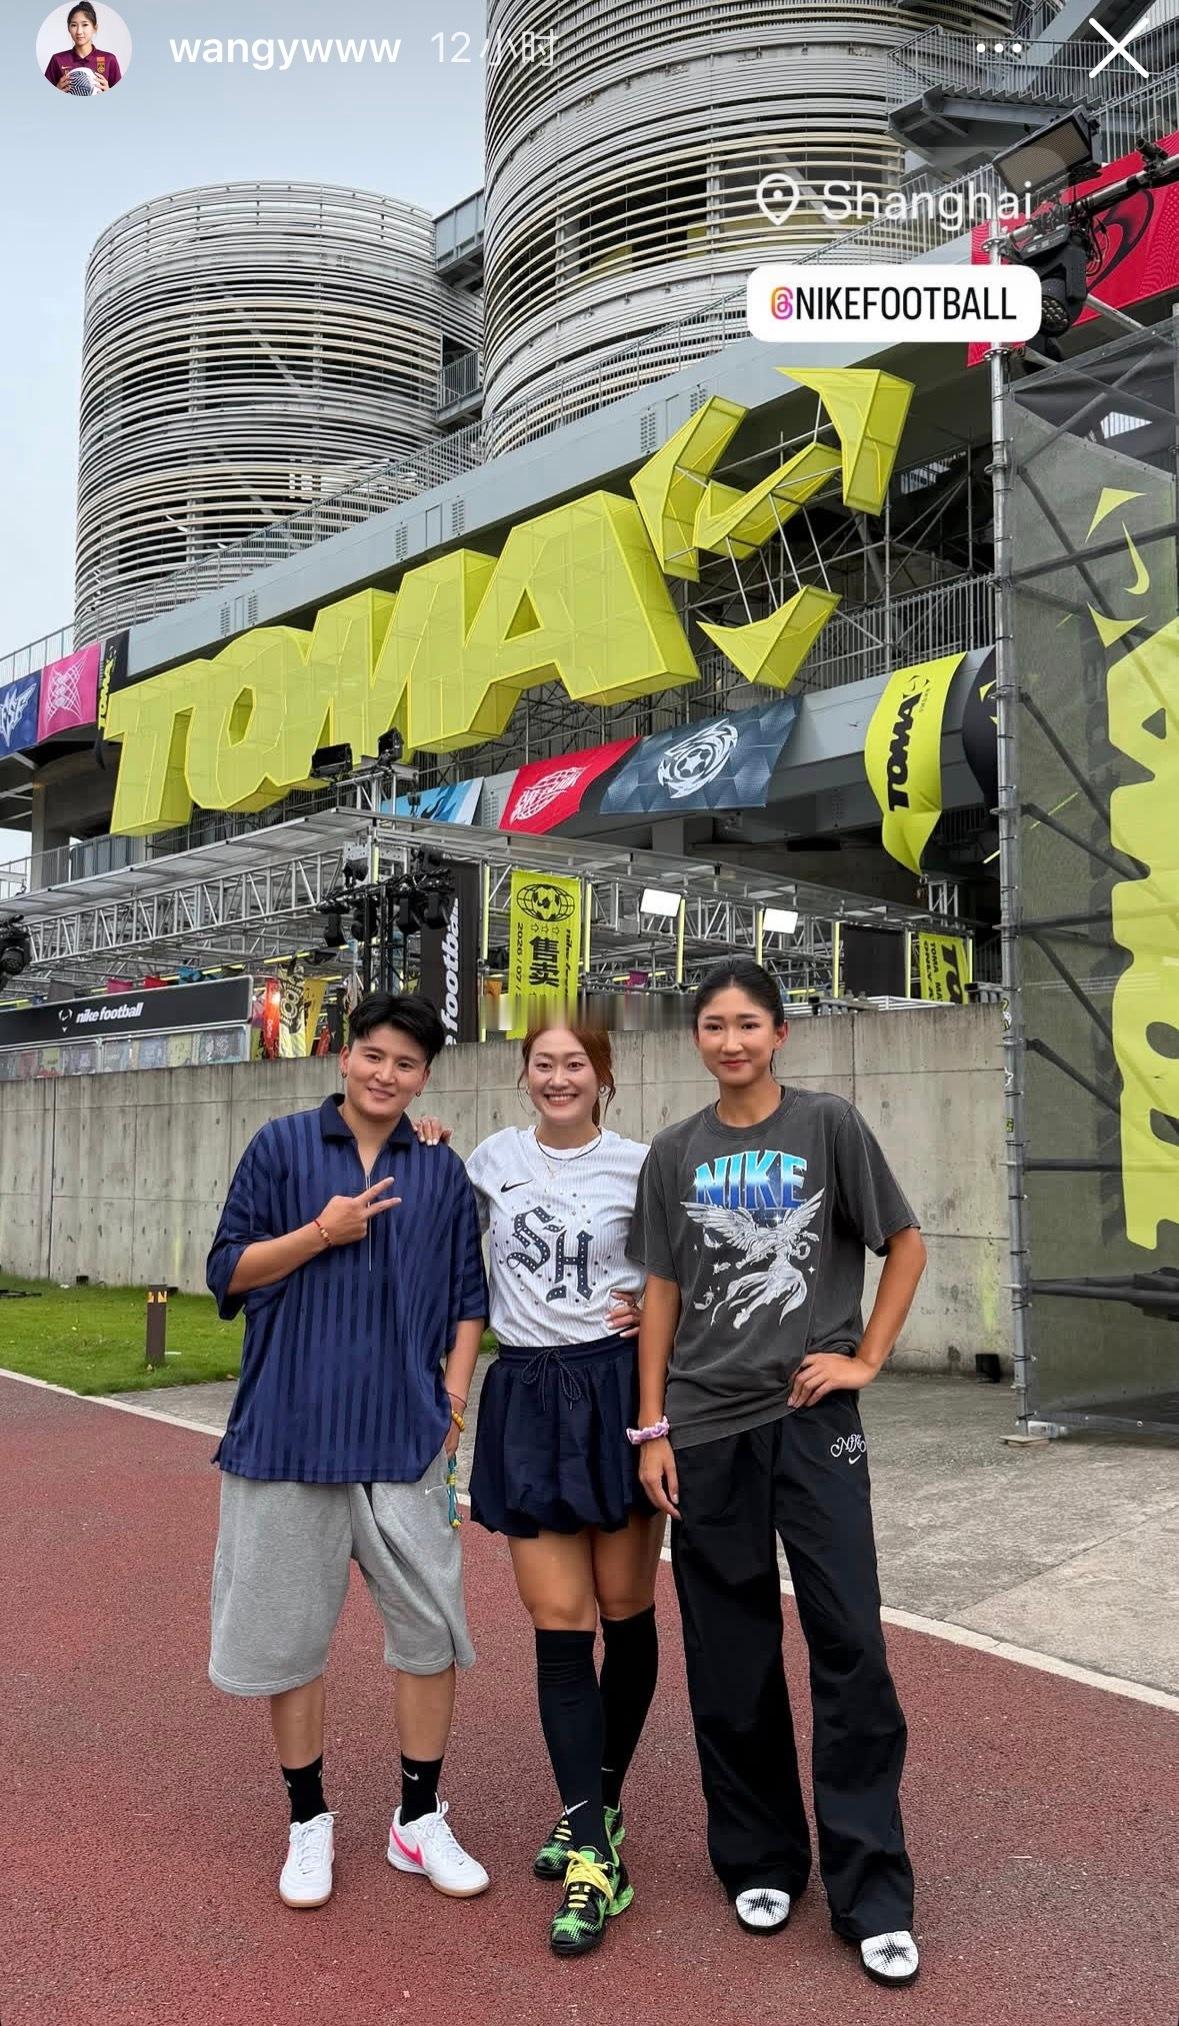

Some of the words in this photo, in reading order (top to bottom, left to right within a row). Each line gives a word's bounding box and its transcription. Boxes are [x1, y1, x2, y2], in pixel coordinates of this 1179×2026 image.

[104, 490, 701, 836] TOMA
[886, 692, 922, 811] TOMA
[529, 935, 559, 988] 售卖
[75, 1007, 99, 1024] nike
[99, 1002, 144, 1021] football
[694, 1150, 807, 1210] NIKE
